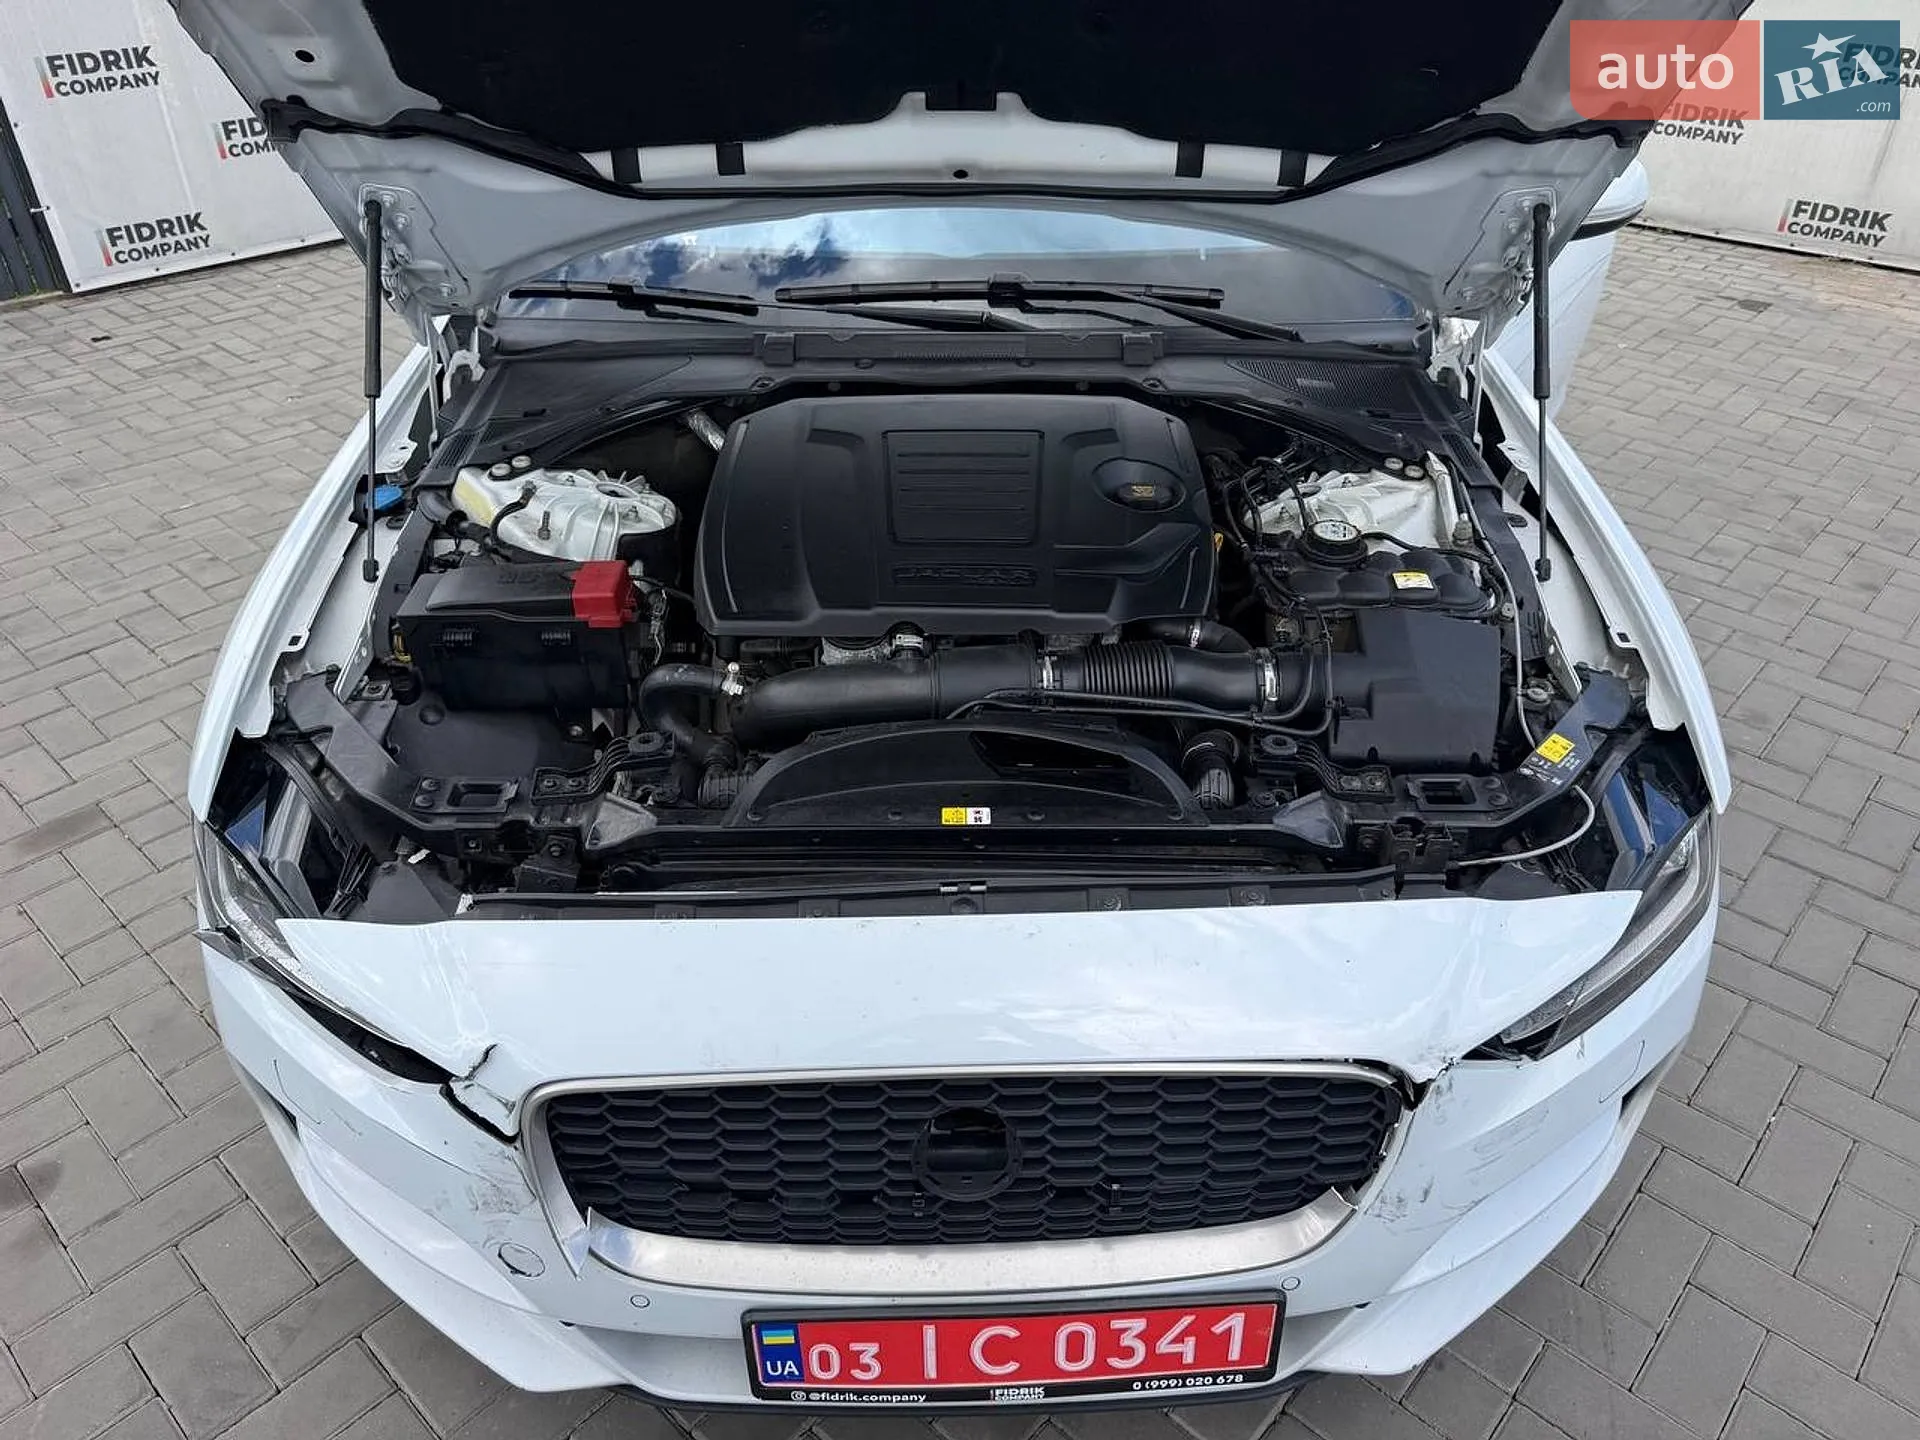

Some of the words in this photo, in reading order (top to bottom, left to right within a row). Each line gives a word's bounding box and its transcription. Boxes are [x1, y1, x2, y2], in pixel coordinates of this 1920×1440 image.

[45, 45, 156, 77] FIDRIK
[54, 71, 161, 97] COMPANY
[1653, 122, 1744, 145] COMPANY
[105, 212, 208, 247] FIDRIK
[1791, 199, 1893, 232] FIDRIK
[1787, 221, 1887, 248] COMPANY
[114, 235, 211, 264] COMPANY
[766, 1360, 799, 1376] UA
[809, 1342, 882, 1380] 03
[1053, 1312, 1246, 1373] 0341
[995, 1386, 1045, 1396] FIDRIK
[1132, 1381, 1141, 1390] 0
[1145, 1378, 1183, 1389] (999)
[1186, 1376, 1213, 1386] 020
[1216, 1374, 1244, 1385] 678
